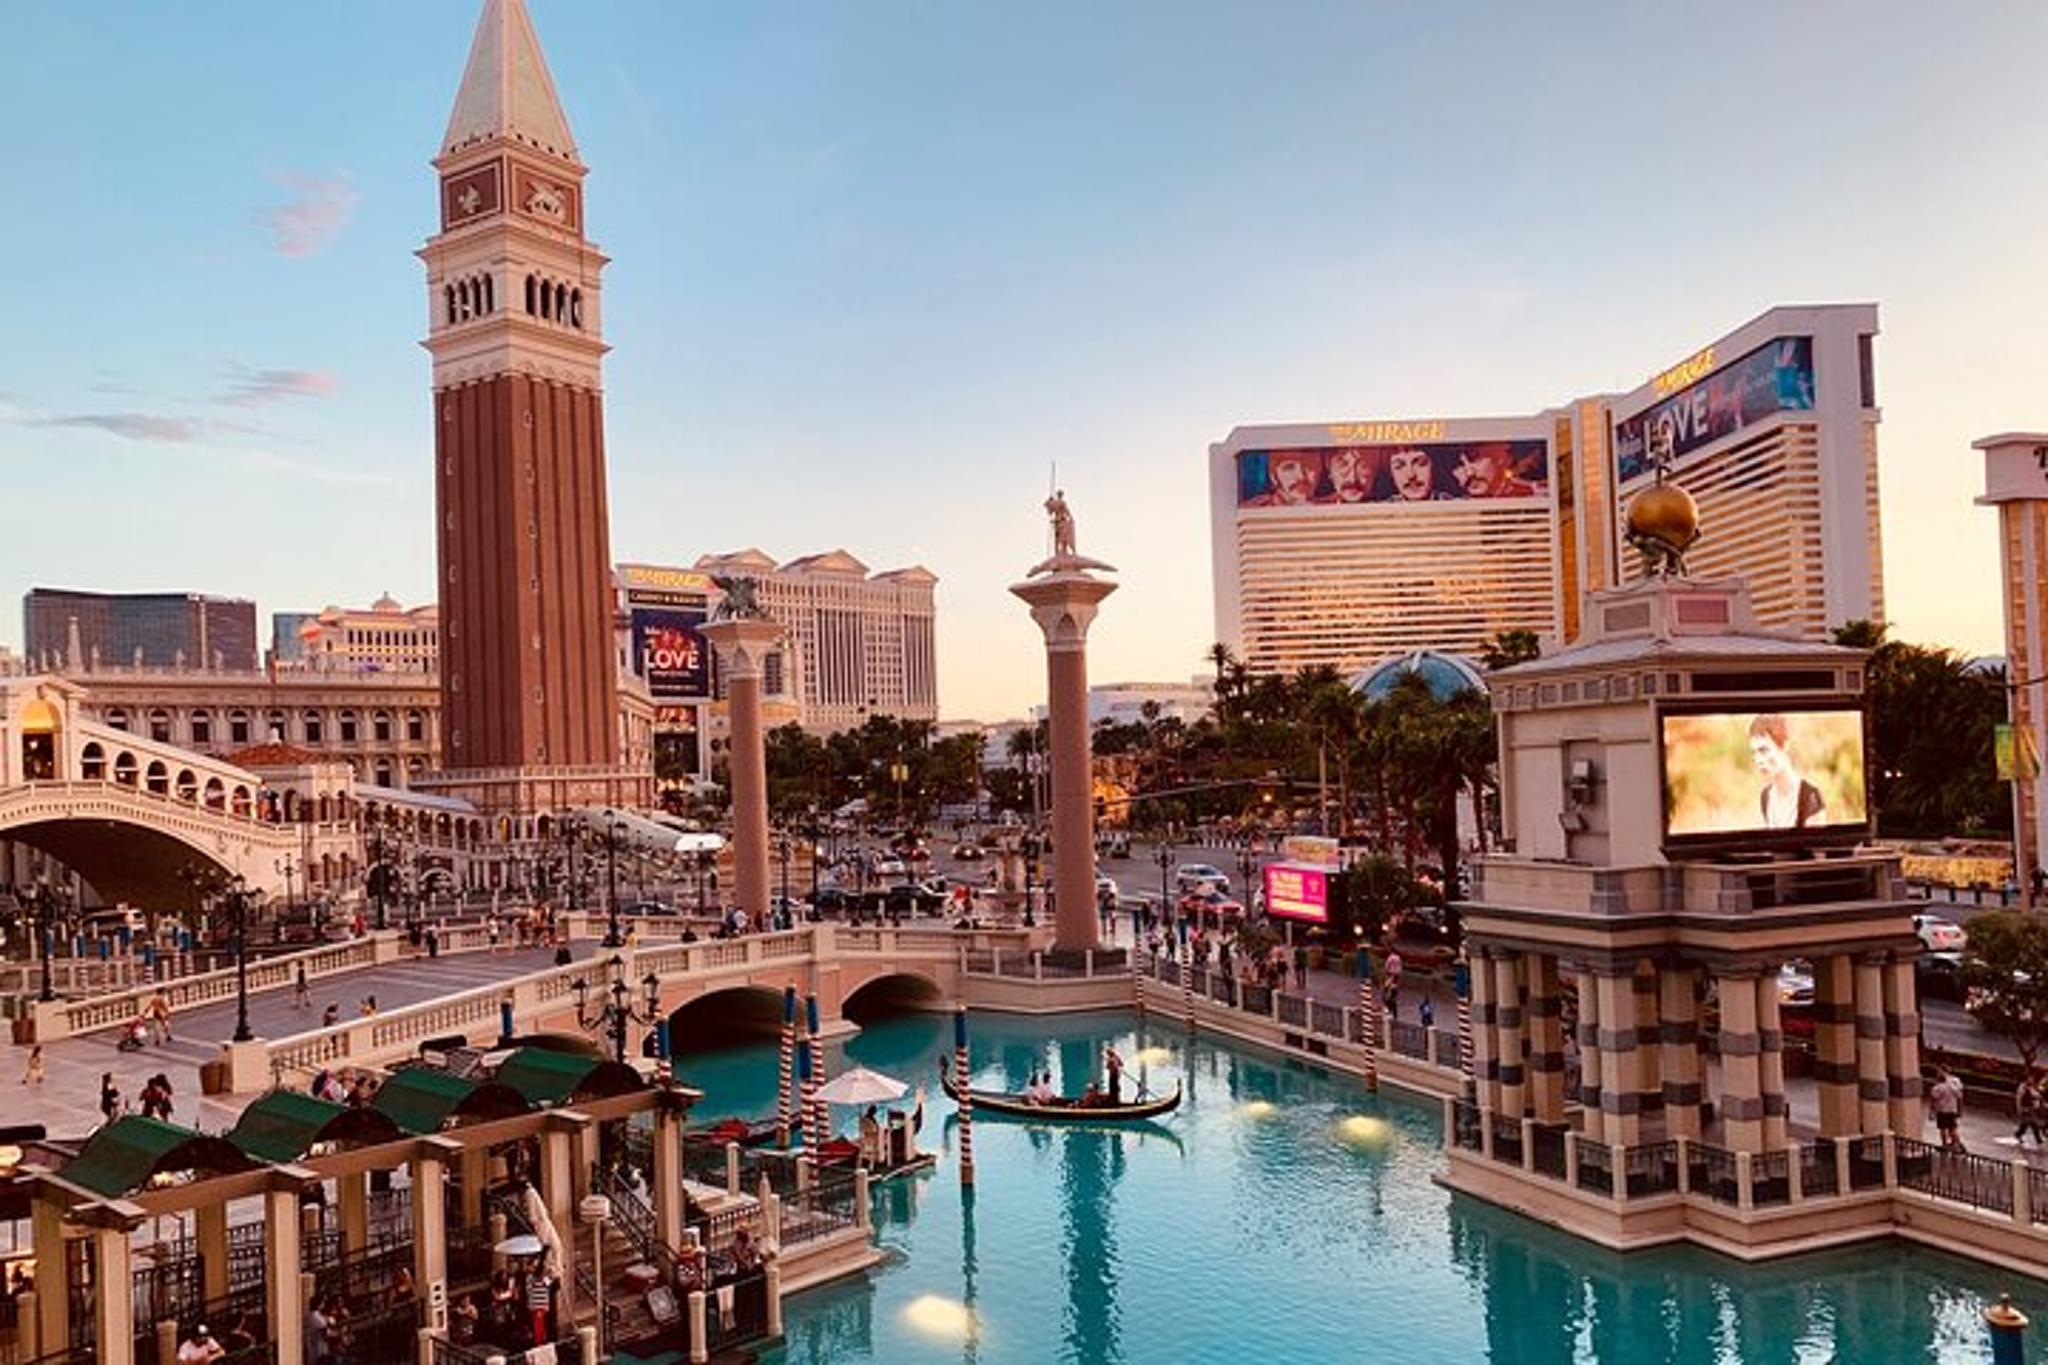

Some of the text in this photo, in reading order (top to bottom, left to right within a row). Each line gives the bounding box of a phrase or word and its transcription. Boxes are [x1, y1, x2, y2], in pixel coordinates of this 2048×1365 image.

[1350, 421, 1446, 441] MIRAGE
[1644, 389, 1708, 459] LOVE
[643, 647, 699, 669] LOVE
